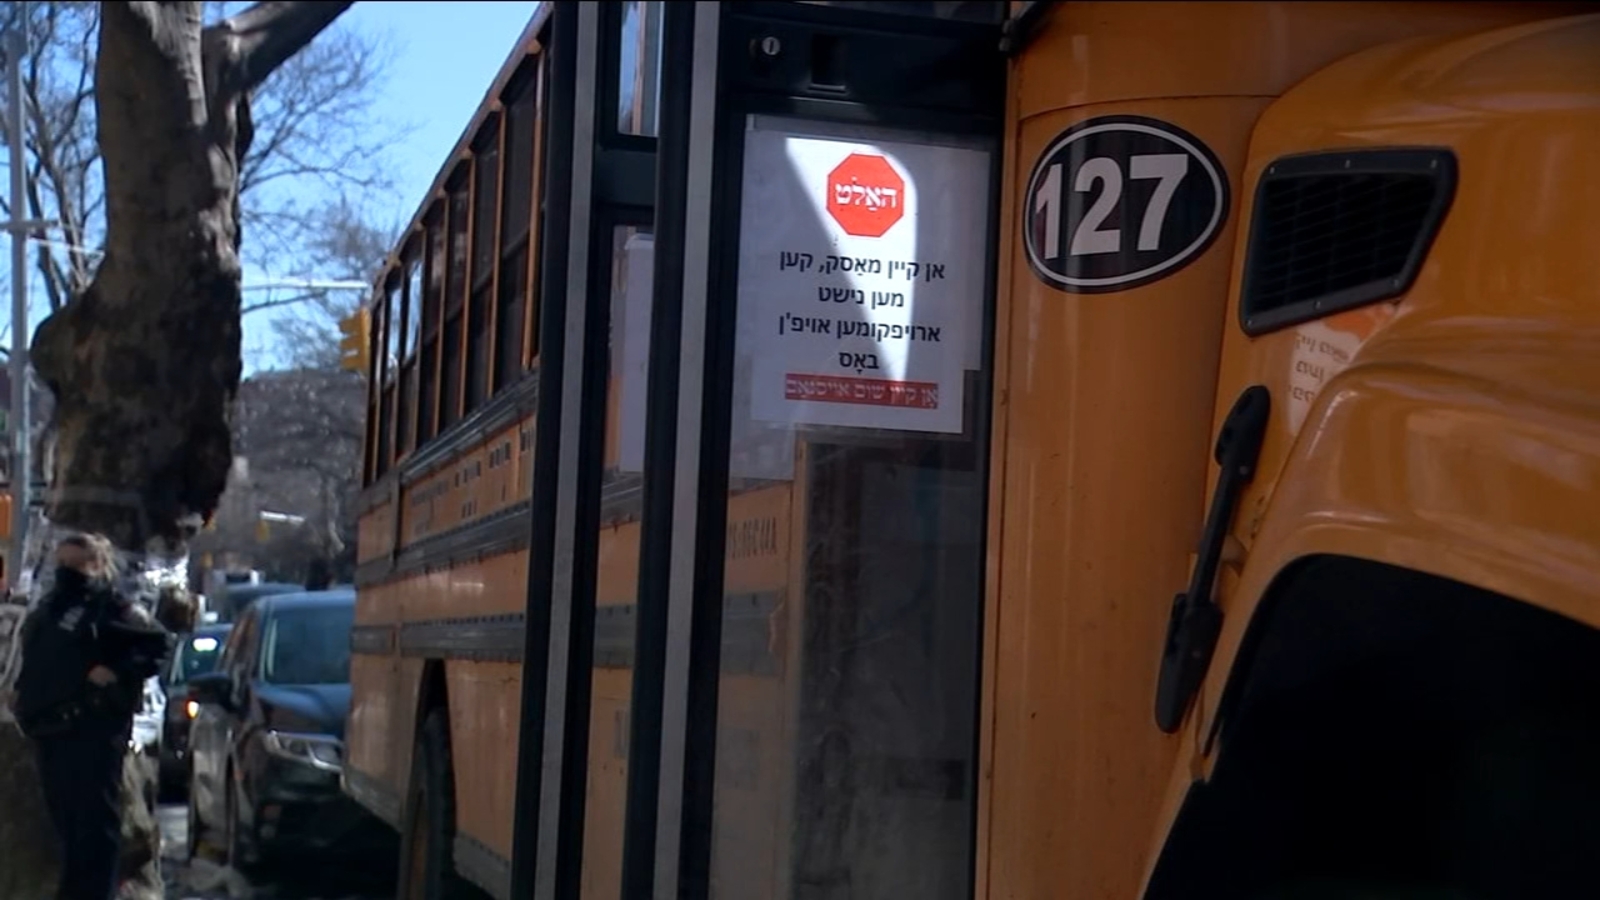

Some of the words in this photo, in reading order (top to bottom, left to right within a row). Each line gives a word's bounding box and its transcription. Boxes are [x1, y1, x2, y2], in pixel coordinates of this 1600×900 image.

[1036, 153, 1189, 260] 127
[779, 251, 814, 273] קען
[888, 260, 920, 281] קיין
[818, 286, 865, 305] נישט
[871, 291, 905, 310] מען
[837, 319, 941, 343] ארויפקומען
